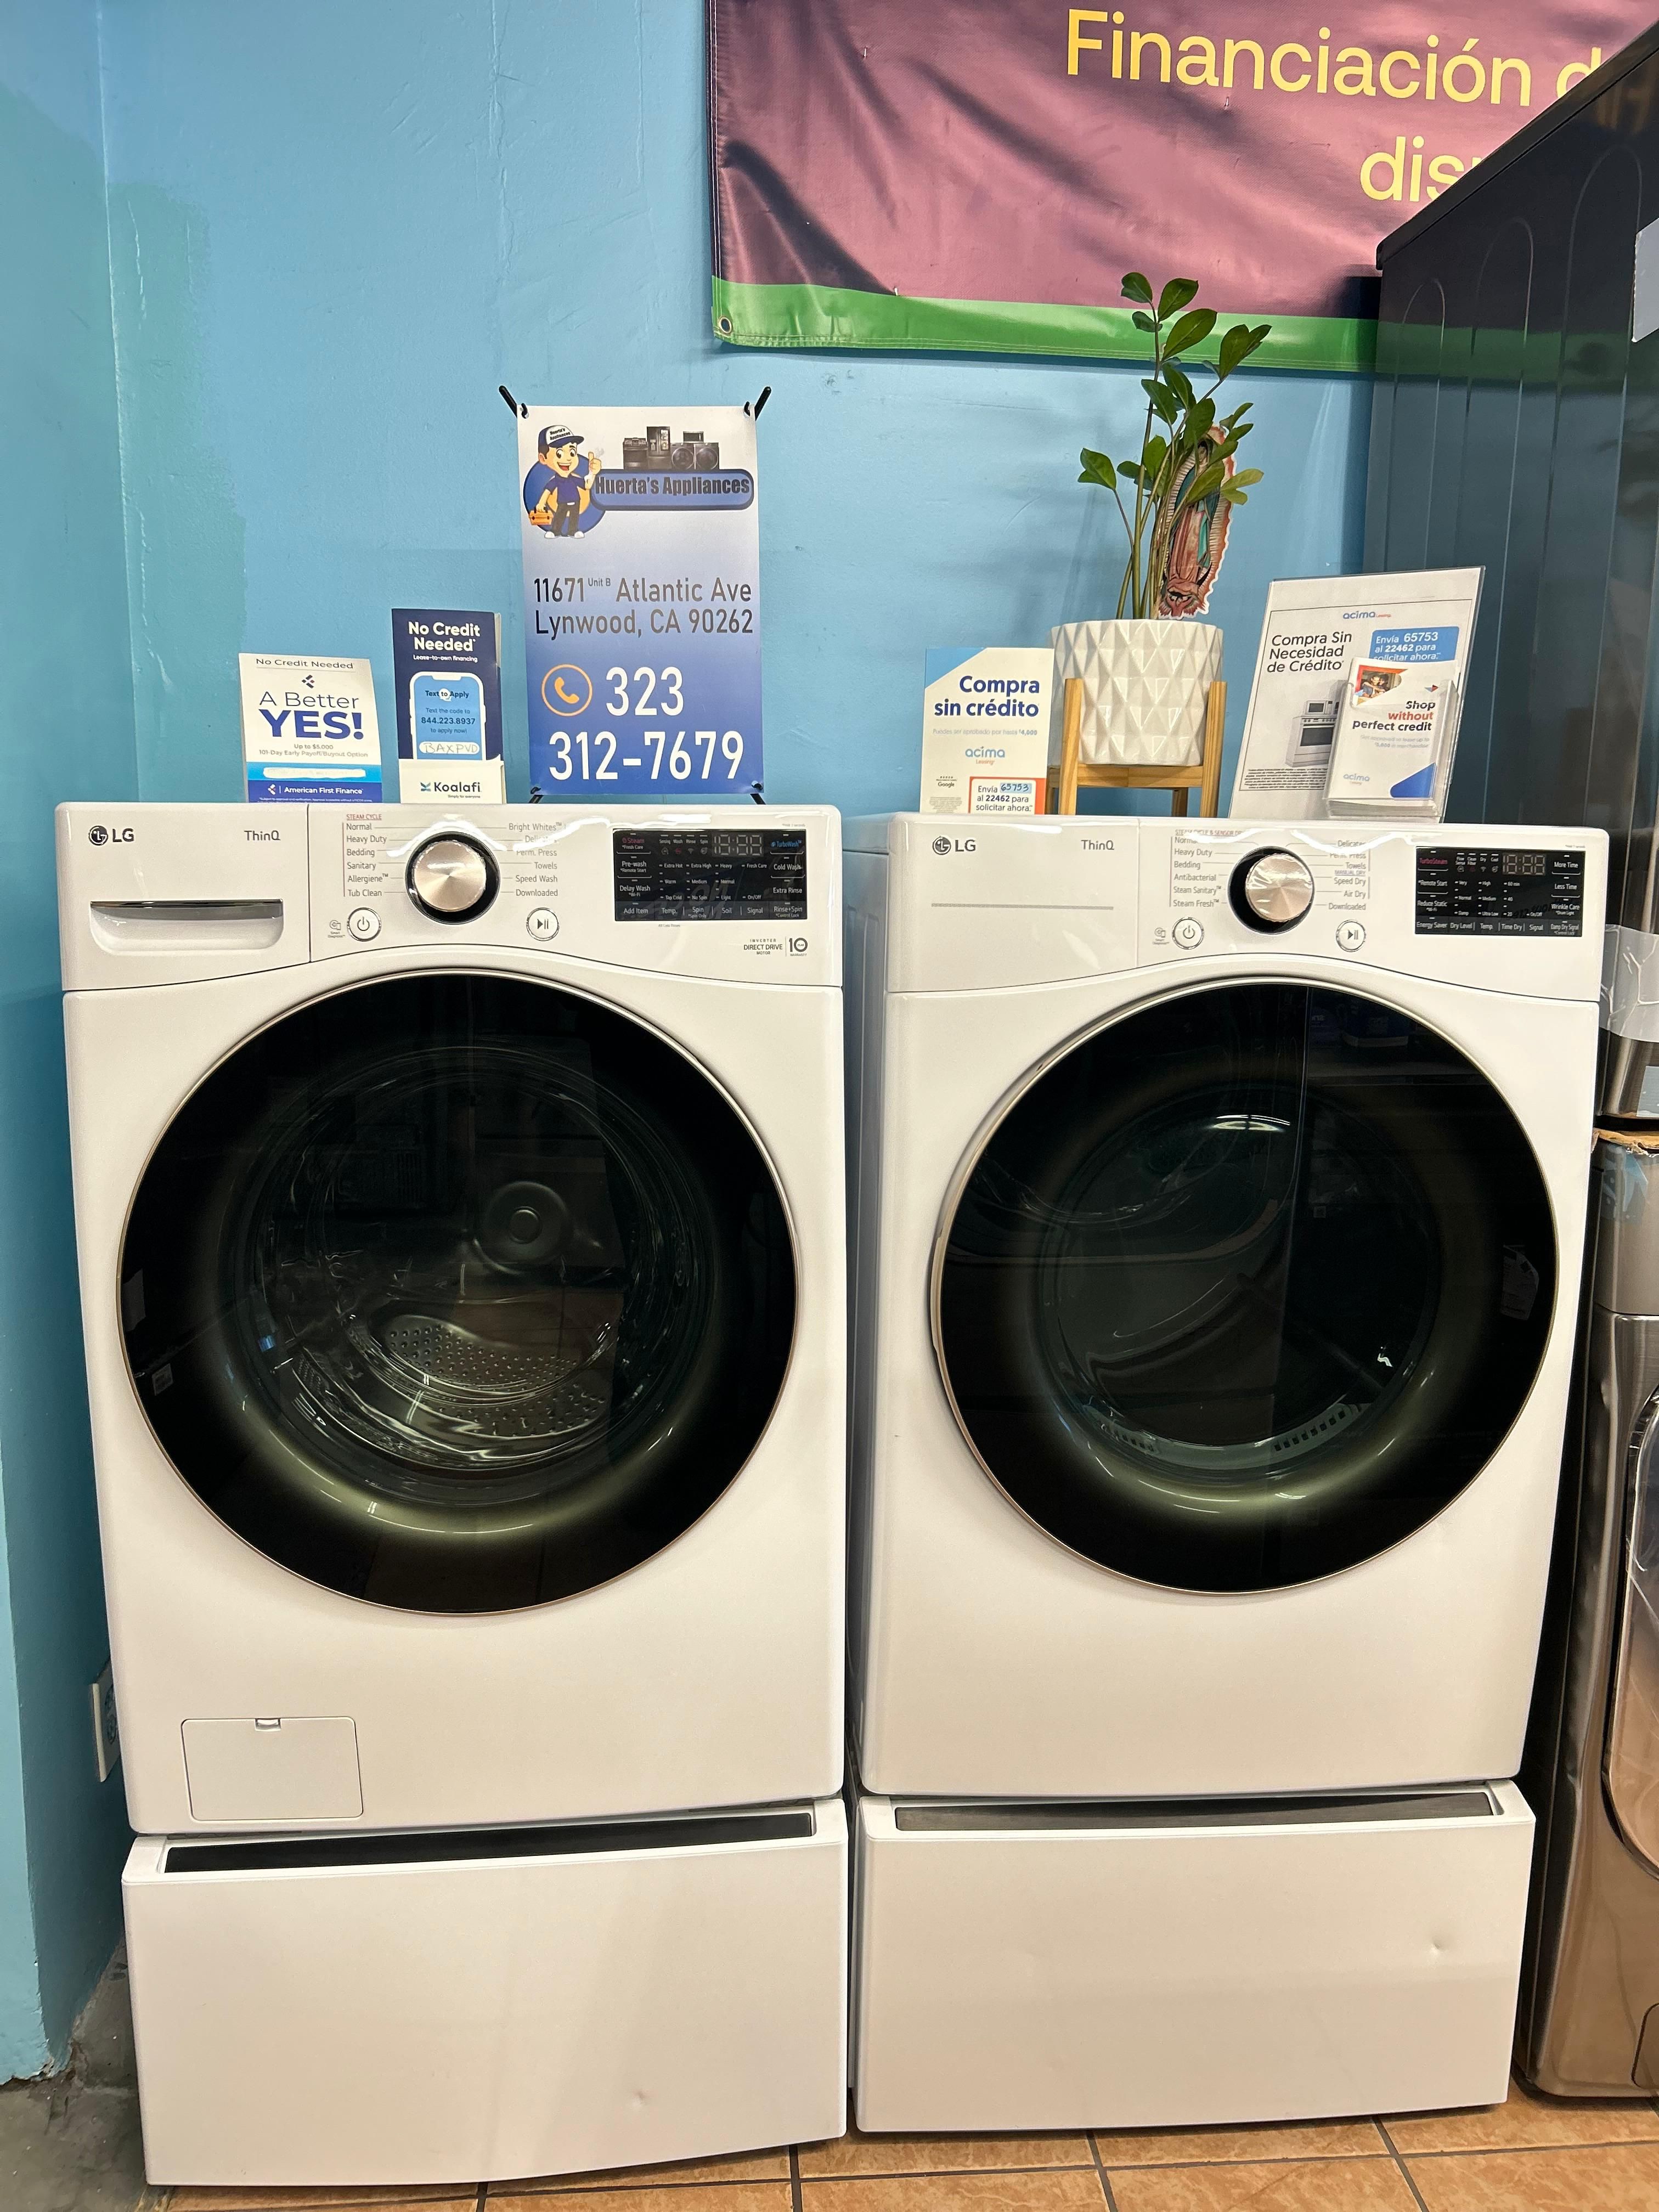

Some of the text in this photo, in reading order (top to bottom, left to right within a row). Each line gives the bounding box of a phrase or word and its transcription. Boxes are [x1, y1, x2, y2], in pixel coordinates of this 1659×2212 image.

[1068, 9, 1531, 106] Financiación
[1360, 136, 1481, 202] dis
[595, 476, 750, 496] Huerta's Appliances
[534, 577, 752, 602] 11671 Unit B Atlantic Ave
[1342, 611, 1376, 620] acima
[408, 621, 481, 637] No Credit
[535, 608, 753, 640] Lynwood, CA 90262
[1272, 631, 1352, 648] Compra Sin
[1376, 631, 1438, 644] Envía 65753
[1269, 645, 1344, 659] Necesidad
[1374, 644, 1436, 653] al 22462 para
[311, 661, 354, 669] Needed
[1267, 661, 1285, 673] de
[605, 666, 684, 716] 323
[960, 675, 1040, 697] Compra
[449, 690, 470, 699] Apply
[259, 691, 359, 709] A Better
[934, 698, 1039, 717] sin crédito
[1406, 701, 1436, 711] Shop
[421, 716, 476, 725] 844.223.8937
[1388, 712, 1434, 721] without
[258, 709, 364, 740] YES!
[1352, 720, 1432, 731] perfect credit
[549, 730, 744, 780] 312-7679
[965, 746, 1006, 758] acima
[1342, 773, 1370, 782] acima
[434, 782, 481, 792] Koalafi
[978, 783, 1029, 793] Envía 65753
[509, 823, 531, 832] Bright
[112, 828, 281, 843] LG ThinQ
[346, 836, 387, 844] Heavy Duty
[955, 839, 1115, 852] LG ThinQ
[346, 849, 376, 857] Bedding
[1174, 848, 1212, 857] Heavy Duty
[347, 861, 376, 871] Sanitary
[534, 861, 557, 870] Towels
[1174, 861, 1201, 870] Bedding
[515, 874, 537, 883] Speed
[1334, 877, 1366, 887] Speed Dry
[516, 888, 558, 896] Downloaded
[1355, 890, 1366, 900] Dry
[692, 906, 705, 914] Spin
[747, 907, 764, 915] Signal
[1328, 902, 1367, 911] Downloaded
[1416, 921, 1433, 929] Energy
[789, 937, 809, 952] 10
